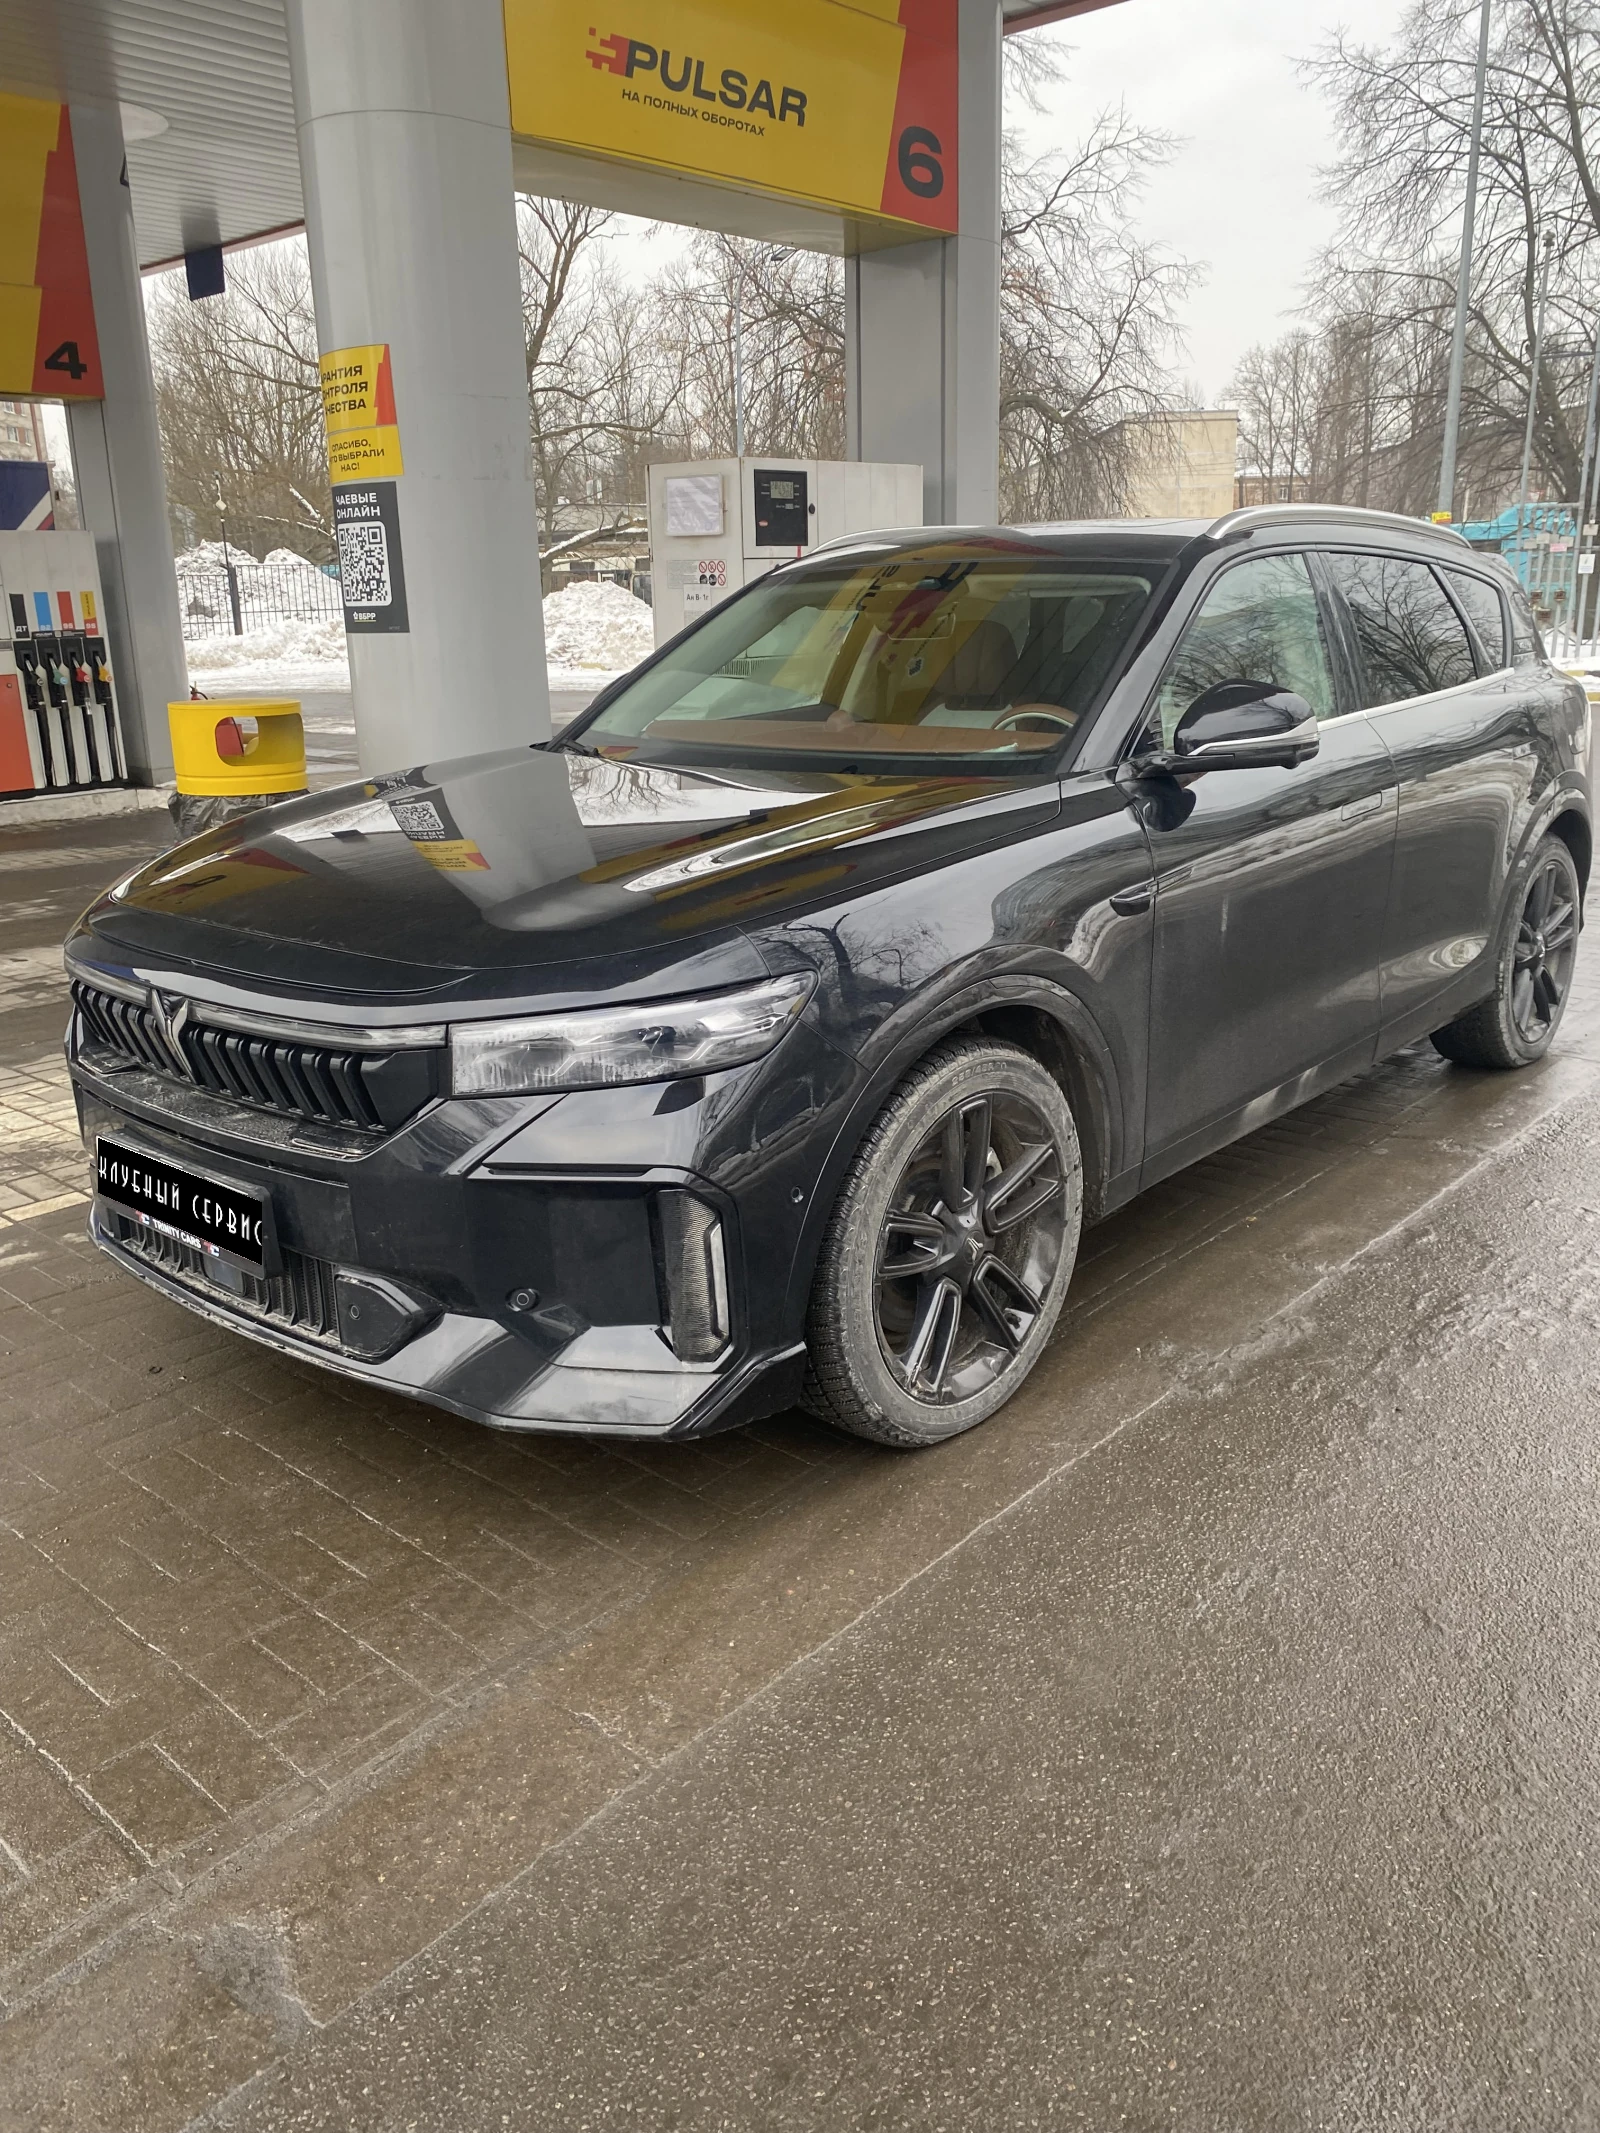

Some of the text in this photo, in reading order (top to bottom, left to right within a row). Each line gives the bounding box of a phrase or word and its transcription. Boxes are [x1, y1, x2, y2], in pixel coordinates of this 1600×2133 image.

[624, 39, 807, 128] PULSAR
[622, 88, 766, 137] НА ПОЛНЫХ ОБОРОТАХ
[898, 126, 944, 198] 6
[45, 341, 88, 380] 4
[320, 365, 363, 384] РАНТИЯ
[338, 448, 385, 462] ВЫБРАЛИ
[340, 462, 360, 472] НАС!
[335, 492, 378, 506] ЧАЕВЫЕ
[336, 505, 381, 519] ОНЛАЙН
[153, 1218, 180, 1239] TRINITY
[180, 1231, 202, 1249] CARS
